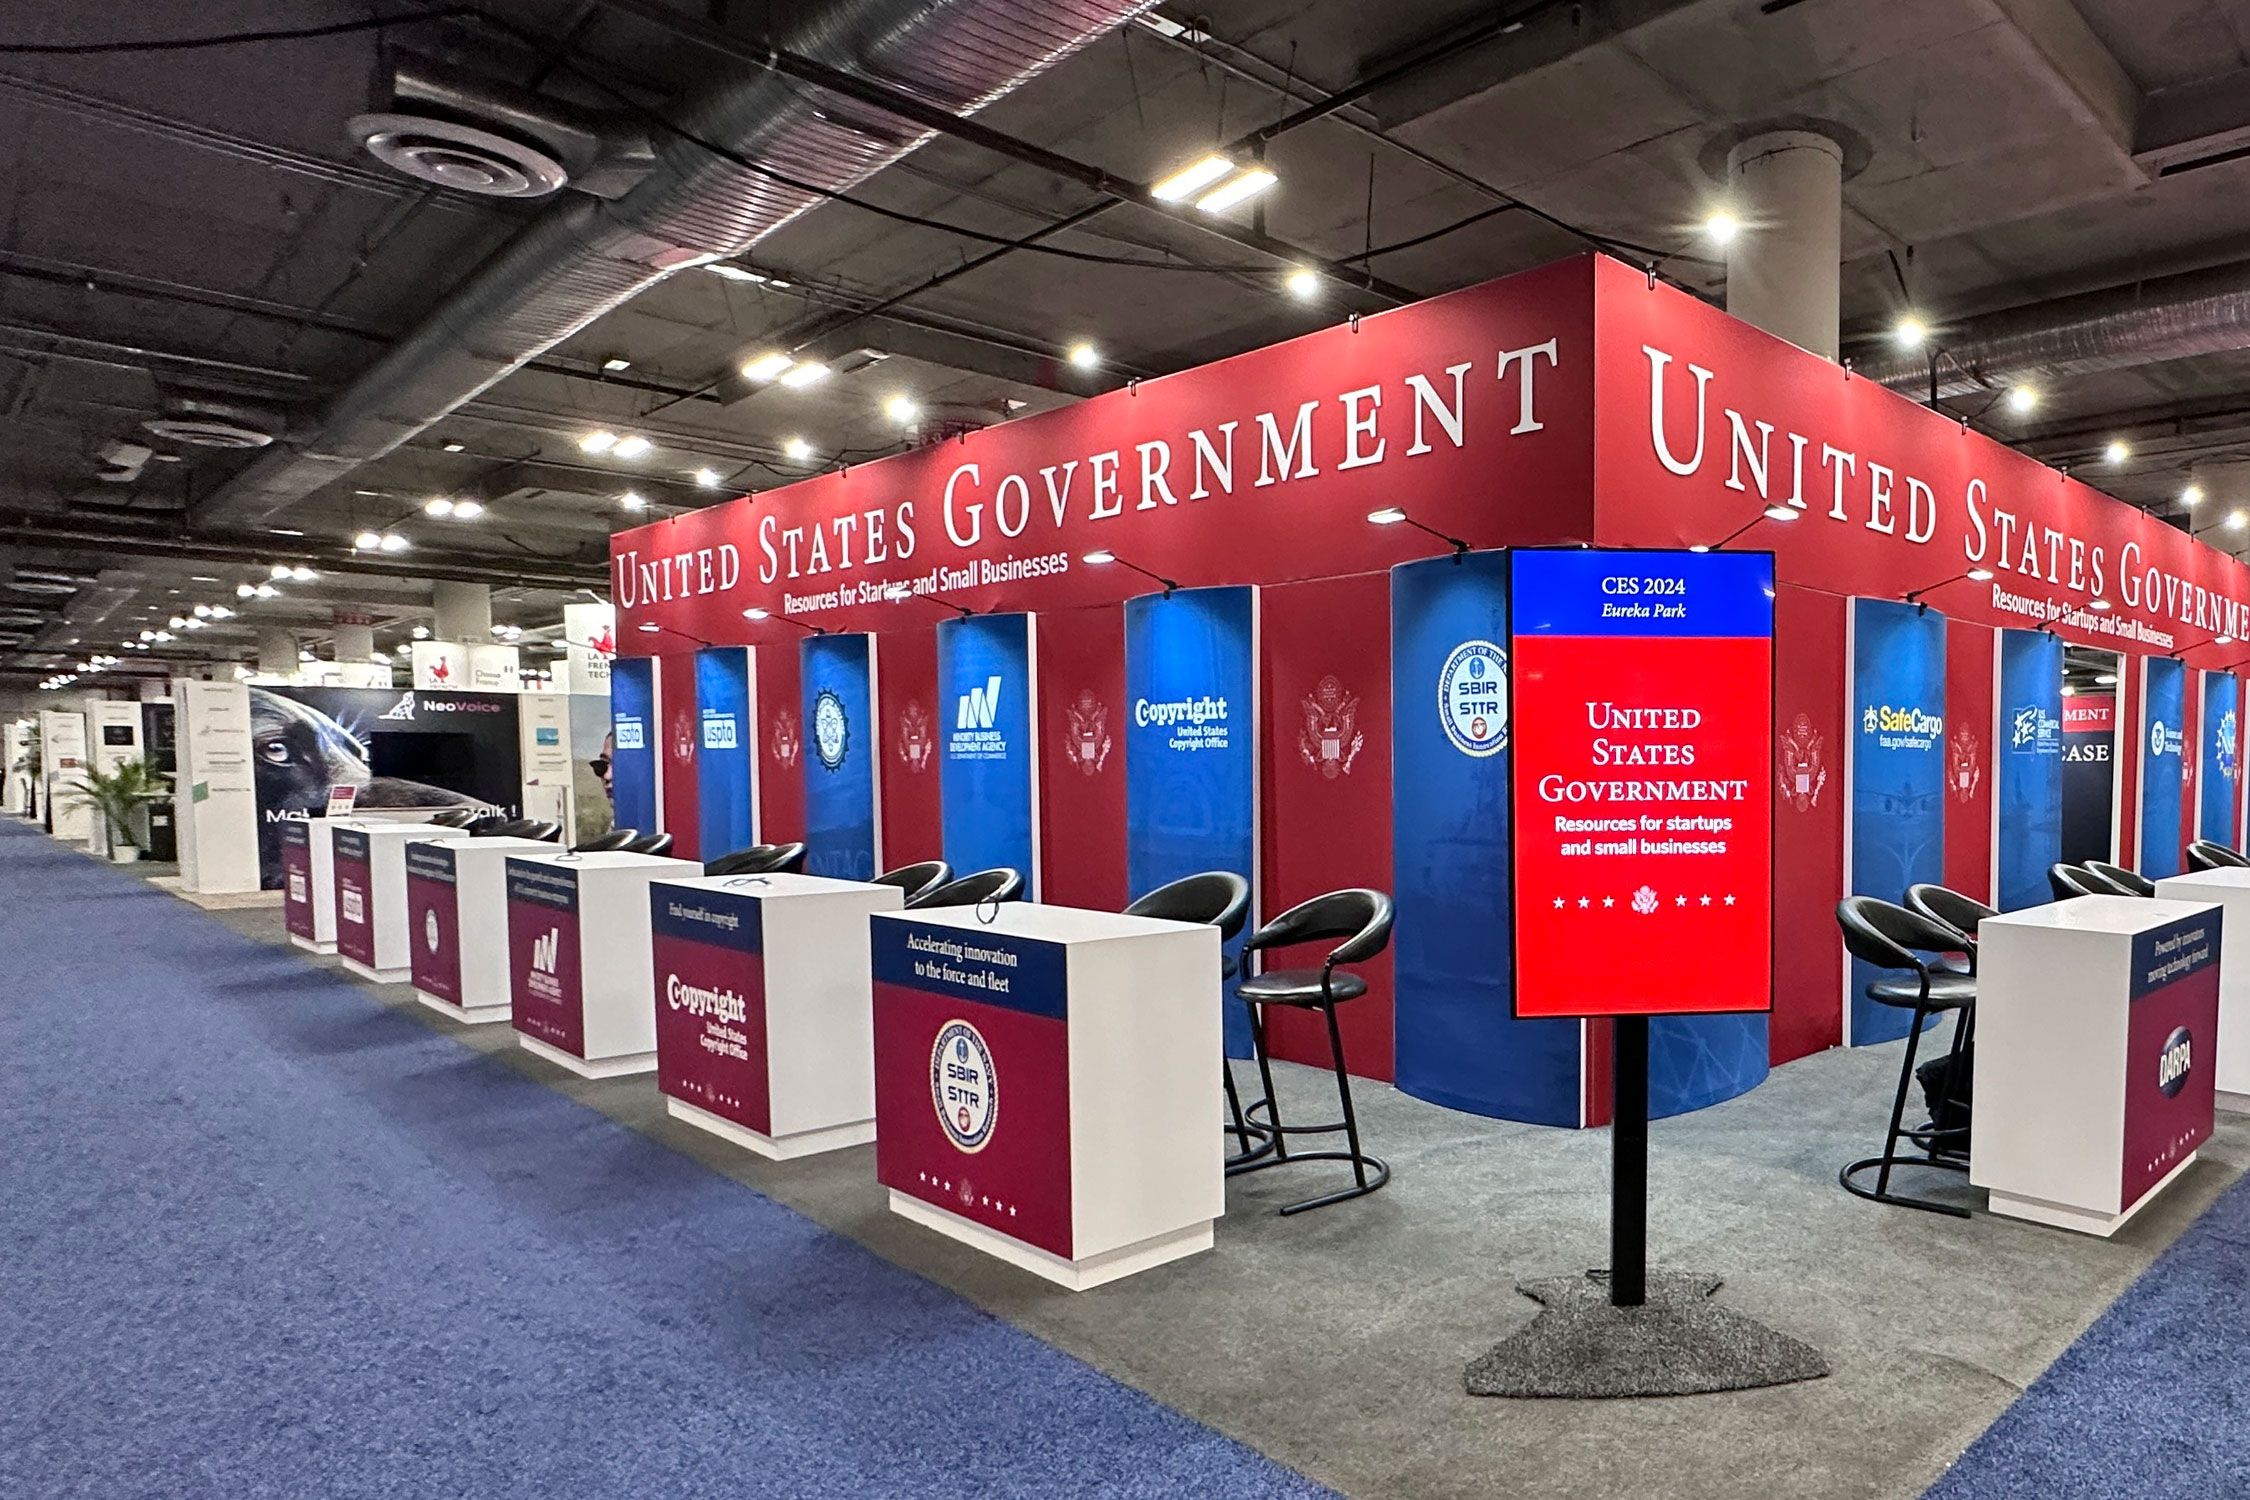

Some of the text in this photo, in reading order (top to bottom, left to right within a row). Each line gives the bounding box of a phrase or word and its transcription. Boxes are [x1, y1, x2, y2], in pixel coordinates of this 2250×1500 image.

[784, 590, 838, 615] Resources
[840, 584, 857, 607] for
[913, 568, 938, 595] and
[940, 560, 978, 592] Small
[981, 552, 1068, 583] Businesses
[1602, 577, 1686, 594] CES 2024
[1602, 603, 1687, 618] Eureka Park
[1992, 583, 2174, 649] Resources for Startups and Small Businesses
[1458, 681, 1498, 695] SBIR
[423, 700, 501, 713] NeoVoice
[1135, 696, 1228, 727] Copyright
[1459, 701, 1498, 715] STTR
[1177, 726, 1228, 737] United States
[1880, 705, 1942, 739] SafeCargo
[1169, 736, 1229, 752] Copyright Office
[2062, 744, 2109, 762] ASE
[1555, 815, 1732, 834] Resources for startups
[1561, 838, 1726, 856] and small businesses
[907, 932, 1018, 967] Accelerating innovation
[915, 960, 1009, 993] to the force and fleet
[667, 973, 746, 1023] Copyright
[2159, 1040, 2190, 1087] DARPA
[947, 1063, 978, 1085] SBIR
[948, 1086, 979, 1108] STTR
